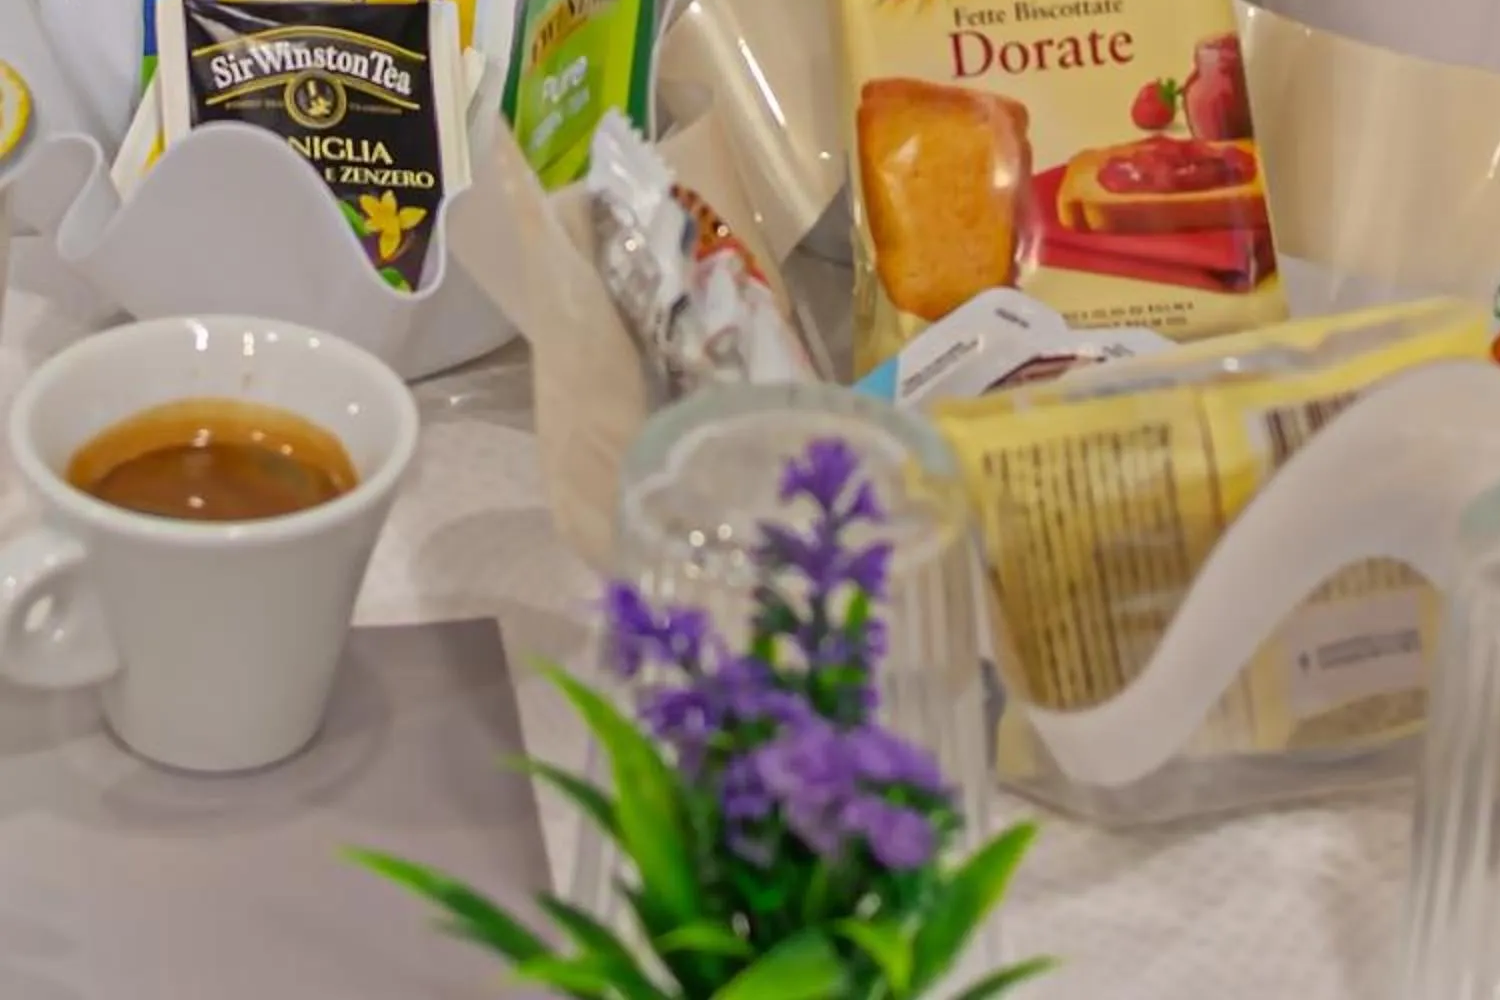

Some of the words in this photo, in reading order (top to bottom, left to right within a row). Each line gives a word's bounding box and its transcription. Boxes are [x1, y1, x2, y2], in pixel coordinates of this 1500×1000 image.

[952, 5, 1008, 28] Fette
[210, 53, 255, 90] Sir
[249, 39, 373, 80] Winston
[369, 50, 413, 97] Tea
[948, 27, 1135, 80] Dorate
[287, 135, 394, 167] NIGLIA
[340, 166, 436, 189] ZENZERO
